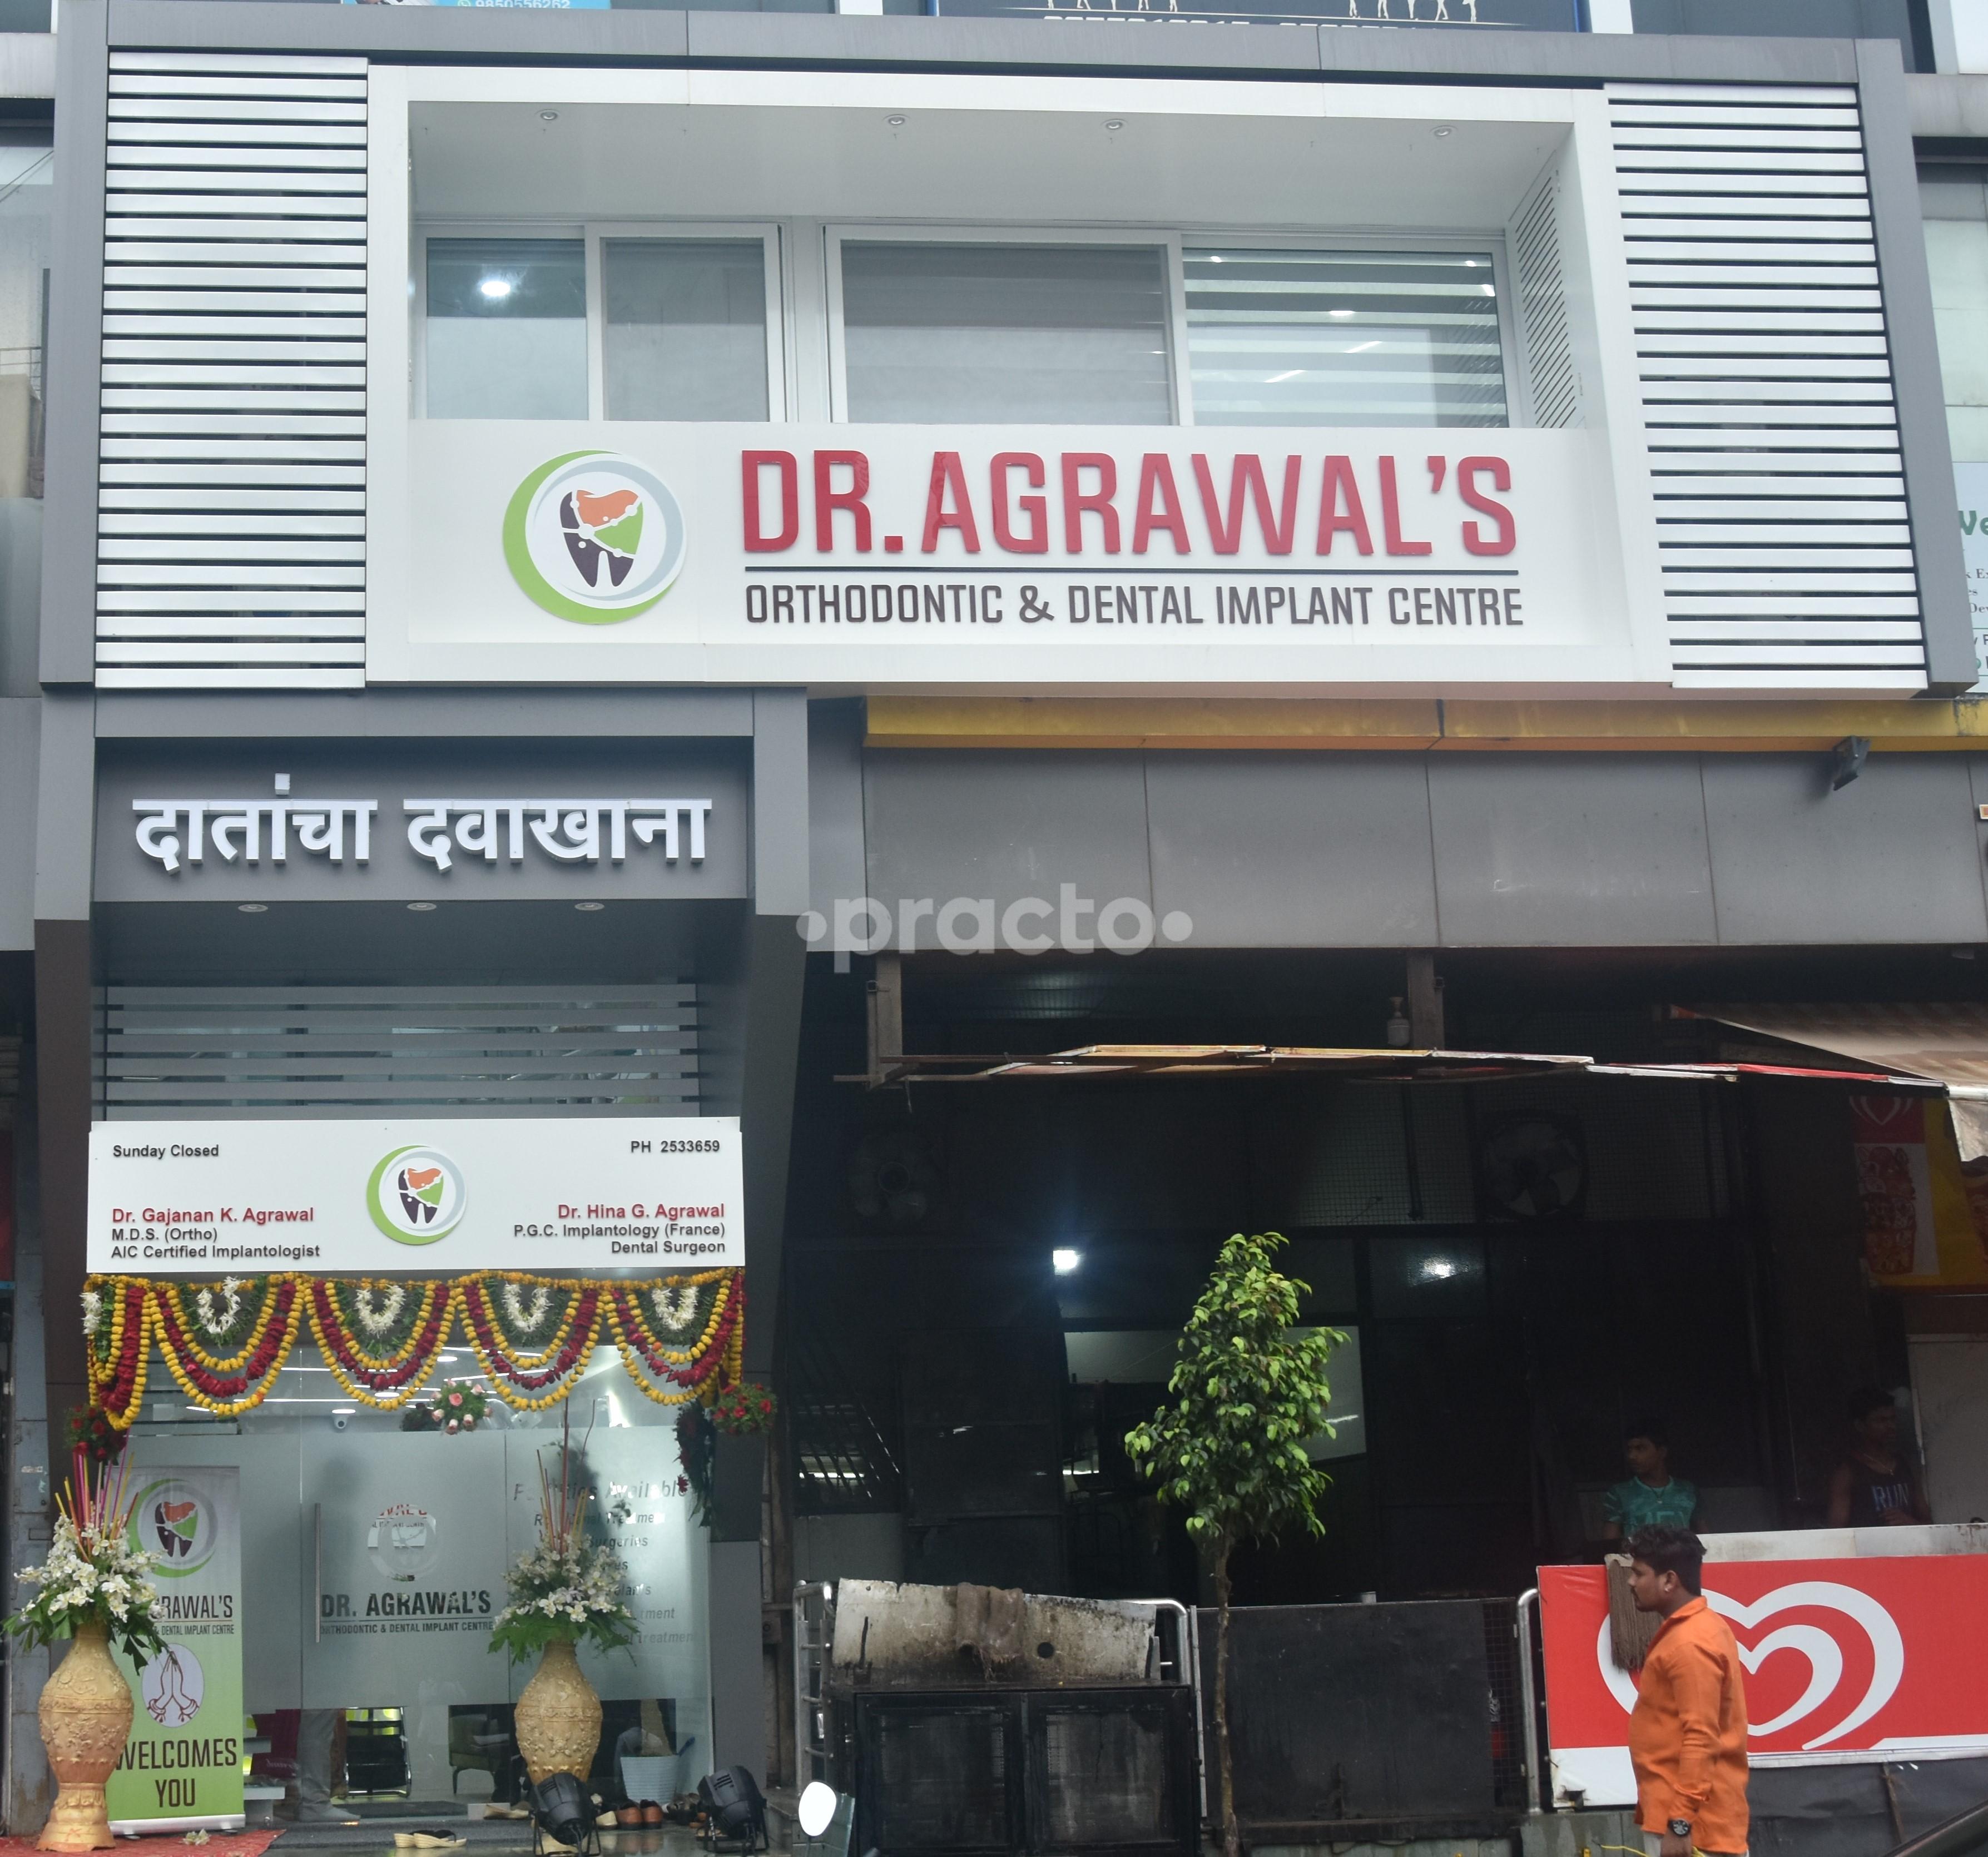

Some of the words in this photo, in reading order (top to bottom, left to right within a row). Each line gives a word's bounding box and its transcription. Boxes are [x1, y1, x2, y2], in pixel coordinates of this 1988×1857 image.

[746, 584, 1003, 624] ORTHODONTIC
[1019, 585, 1054, 622] &
[1068, 585, 1203, 624] DENTAL
[1216, 586, 1372, 624] IMPLANT
[1388, 587, 1523, 625] CENTRE
[132, 773, 378, 873] दातांचा
[403, 798, 712, 873] दवाखाना
[113, 1145, 165, 1159] Sunday
[170, 1144, 219, 1157] Closed
[631, 1141, 652, 1153] PH
[661, 1140, 720, 1153] 2533659
[112, 1209, 135, 1222] Dr.
[142, 1208, 214, 1226] Gajanan
[220, 1208, 237, 1222] K.
[243, 1207, 314, 1225] Agrawal
[558, 1205, 581, 1219] Dr.
[587, 1204, 626, 1218] Hina
[632, 1204, 650, 1218] G.
[655, 1203, 725, 1222] Agrawal
[112, 1228, 159, 1241] M.D.S.
[165, 1228, 217, 1243] (Ortho)
[514, 1224, 558, 1237] P.G.C.
[563, 1224, 660, 1239] Implantology
[665, 1223, 725, 1238] (France)
[111, 1246, 137, 1258] AIC
[143, 1245, 206, 1258] Certified
[212, 1245, 320, 1261] Implantologist
[612, 1241, 658, 1254] Dental
[663, 1240, 726, 1255] Surgeon
[151, 1595, 232, 1620] RAWAL'S
[321, 1594, 356, 1617] DR.
[366, 1590, 492, 1616] AGRAWAL'S
[162, 1625, 183, 1636] DENTAL
[185, 1624, 211, 1636] IMPLANT
[212, 1623, 234, 1635] CENTRE
[320, 1623, 377, 1635] ORTHODONTIC
[380, 1623, 386, 1633] &
[390, 1622, 419, 1633] DENTAL
[422, 1621, 459, 1632] IMPLANT
[462, 1620, 493, 1631] CENTRE
[116, 1738, 237, 1770] WELCOMES
[155, 1778, 195, 1808] YOU
